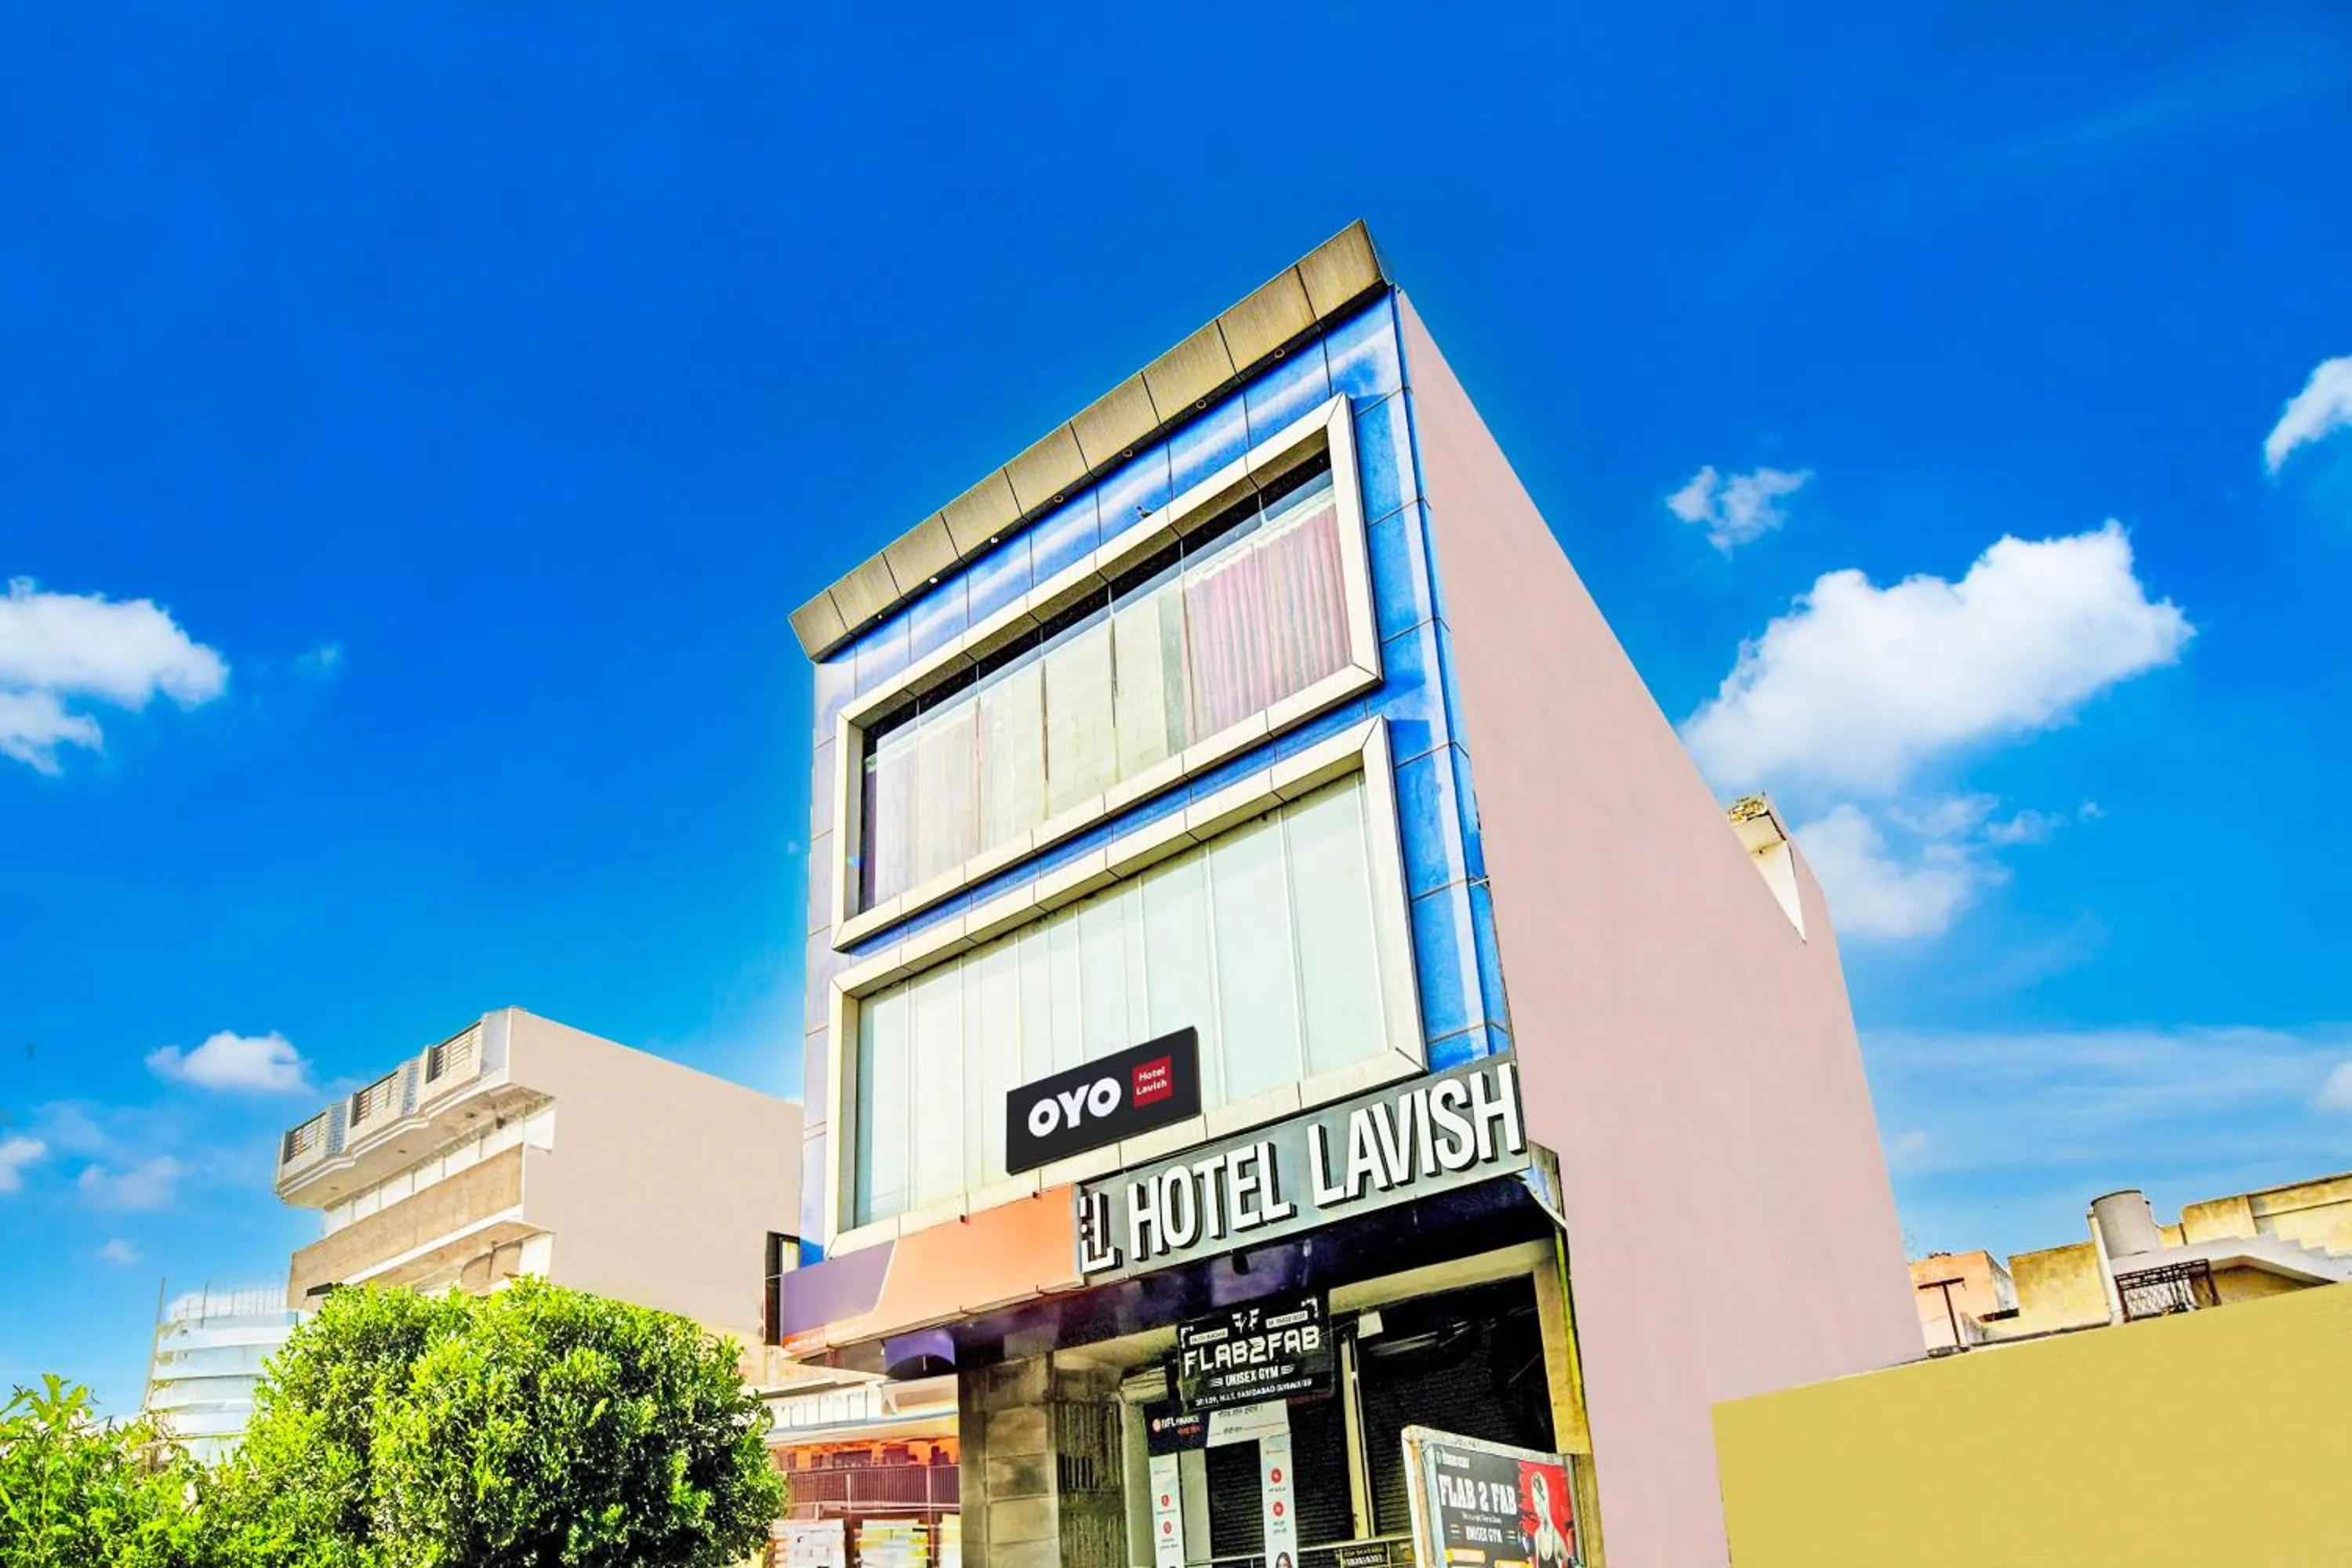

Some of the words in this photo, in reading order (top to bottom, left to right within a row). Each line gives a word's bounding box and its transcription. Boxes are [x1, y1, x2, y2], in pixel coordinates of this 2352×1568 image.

[1136, 1078, 1167, 1095] Lavish
[1138, 1065, 1166, 1082] Hotel
[1028, 1076, 1122, 1138] OYO
[1127, 1142, 1294, 1261] HOTEL
[1307, 1062, 1526, 1208] LAVISH
[1183, 1324, 1319, 1377] FLAB2FAB
[1225, 1370, 1257, 1386] UNISEX
[1258, 1365, 1279, 1380] GYM
[1437, 1473, 1476, 1510] FLAB
[1478, 1480, 1489, 1512] 2
[1490, 1482, 1518, 1515] FAB
